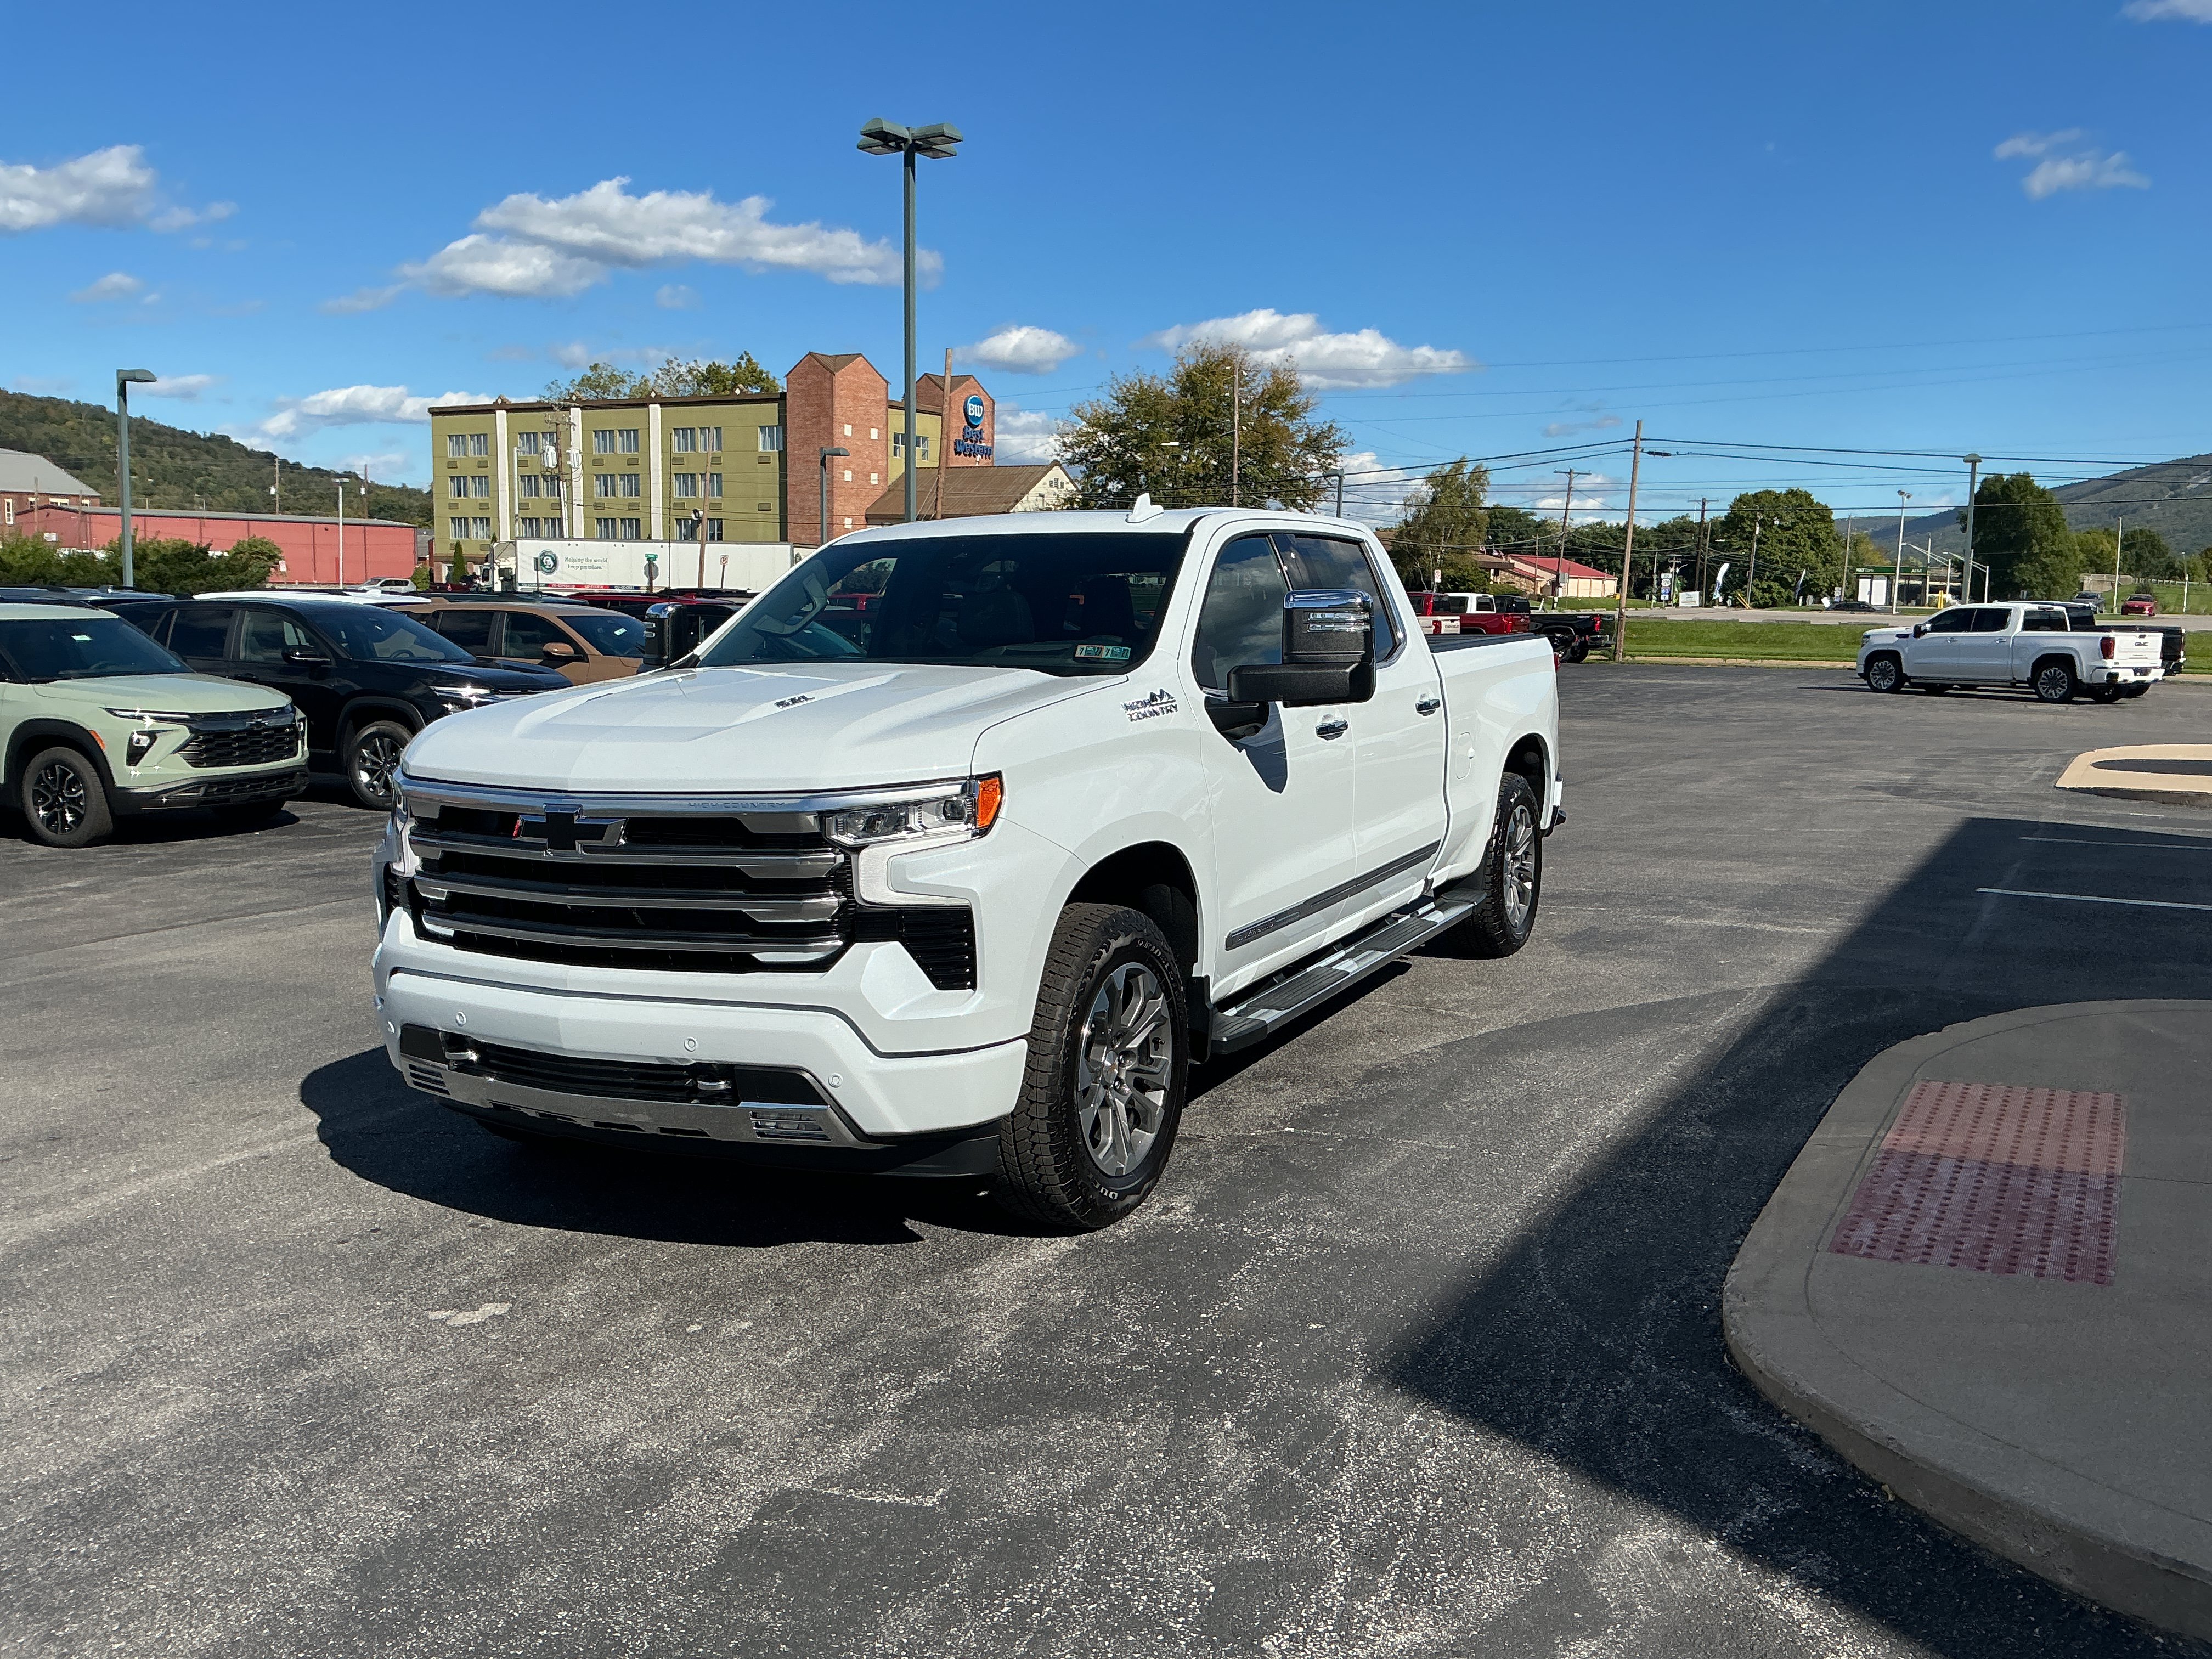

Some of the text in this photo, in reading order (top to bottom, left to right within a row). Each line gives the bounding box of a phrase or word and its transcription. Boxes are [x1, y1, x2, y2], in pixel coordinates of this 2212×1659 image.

[968, 403, 983, 417] BW
[963, 426, 985, 441] Best
[955, 439, 992, 456] Western
[1127, 703, 1178, 723] COUNTRY
